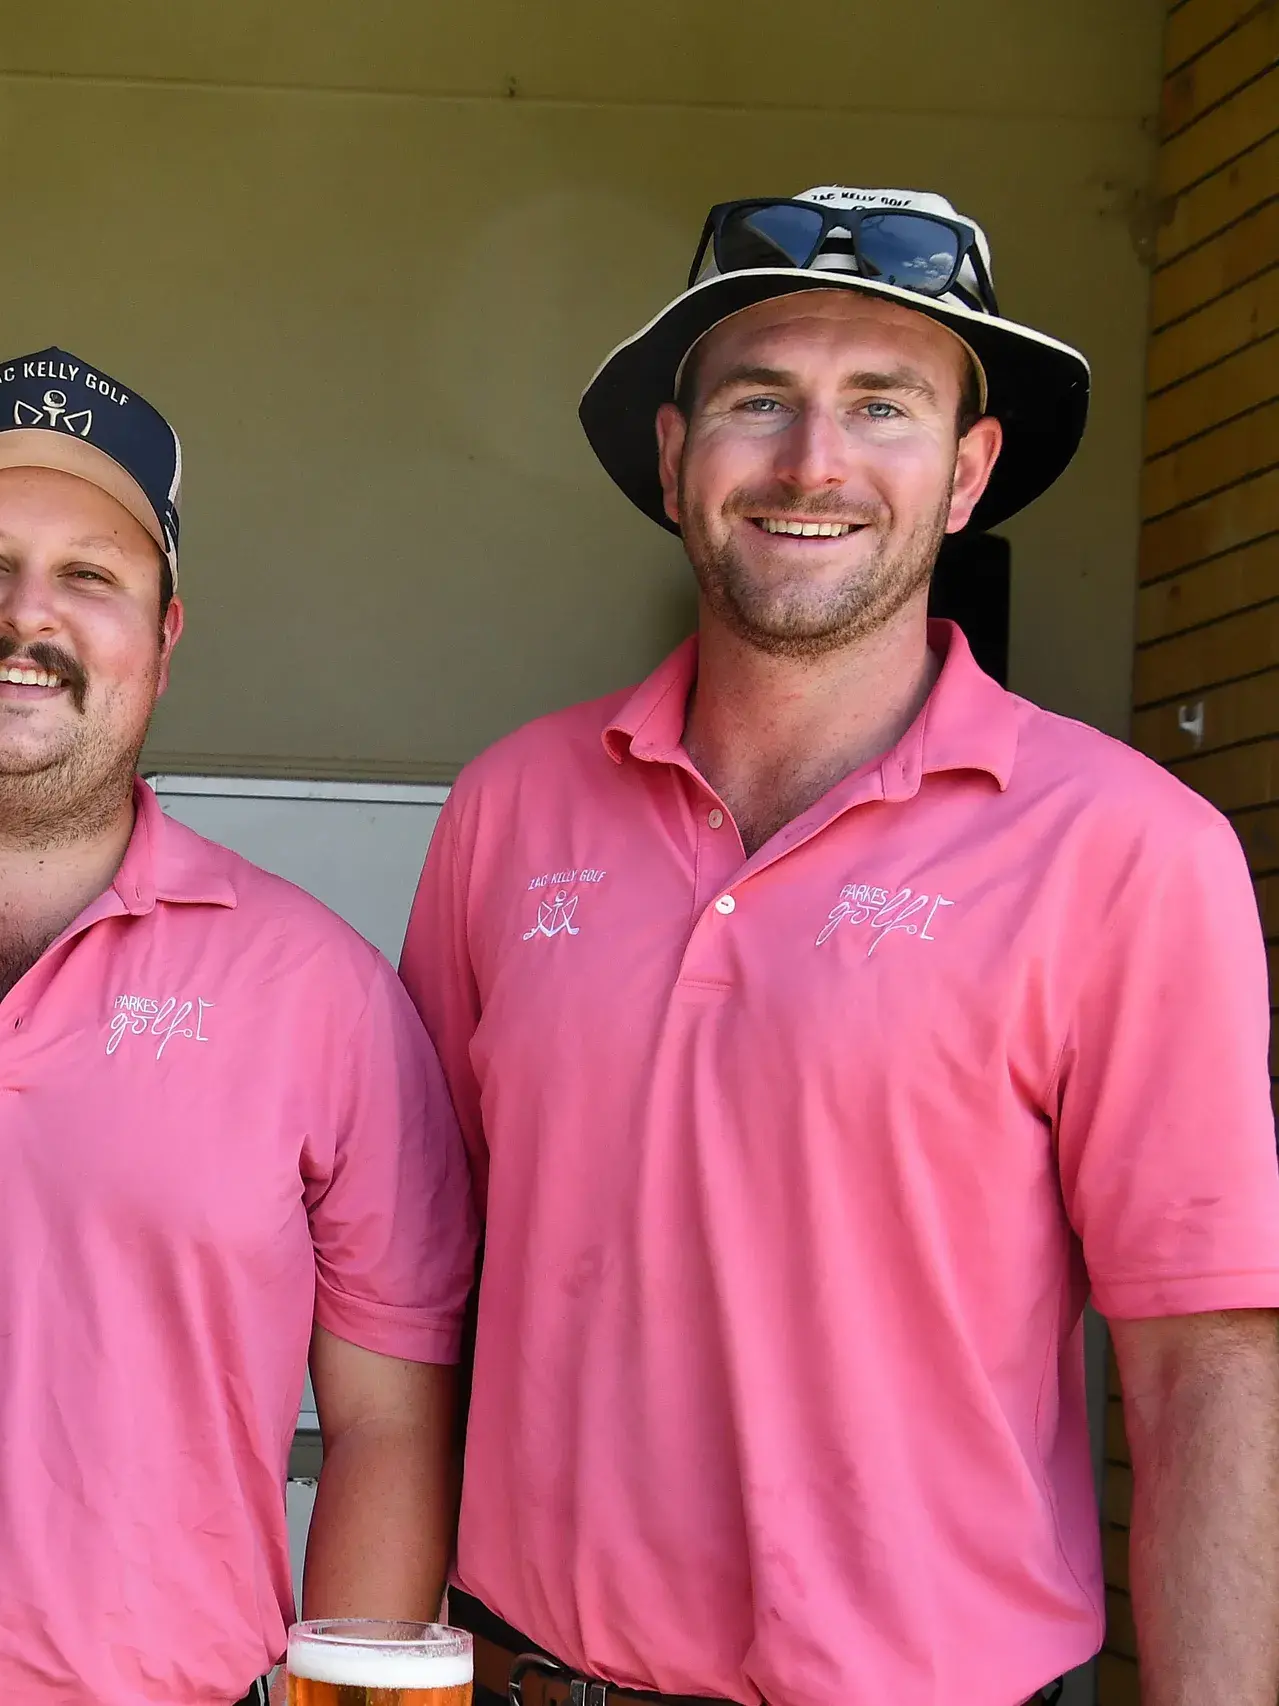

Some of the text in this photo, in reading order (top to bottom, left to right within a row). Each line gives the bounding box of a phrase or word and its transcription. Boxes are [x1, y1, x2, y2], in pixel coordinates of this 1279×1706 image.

[23, 361, 80, 381] KELLY
[85, 373, 130, 406] GOLF
[528, 869, 607, 890] ZAC KELLY GOLF
[840, 884, 889, 905] PARKES
[815, 888, 918, 957] golf
[114, 994, 159, 1014] PARKES
[106, 996, 193, 1060] golf
